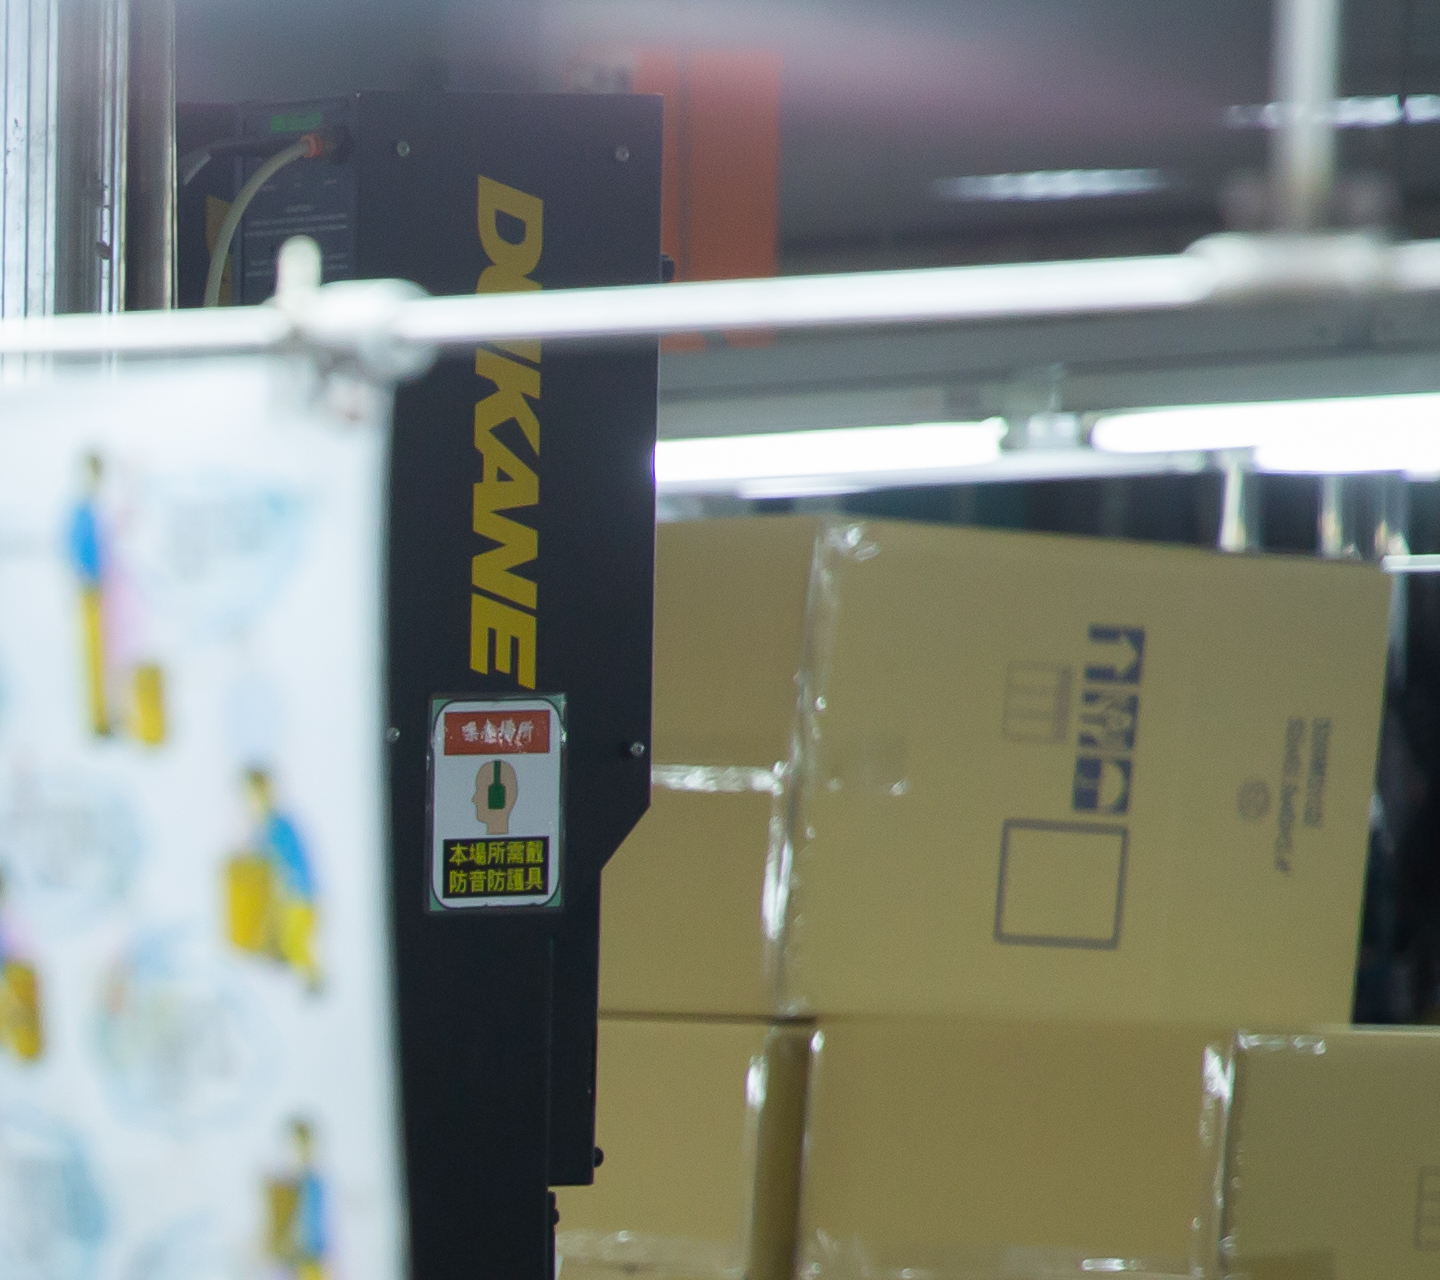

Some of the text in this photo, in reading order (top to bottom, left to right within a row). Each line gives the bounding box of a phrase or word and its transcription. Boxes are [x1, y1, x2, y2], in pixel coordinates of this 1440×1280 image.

[448, 866, 544, 894] 防音防護具
